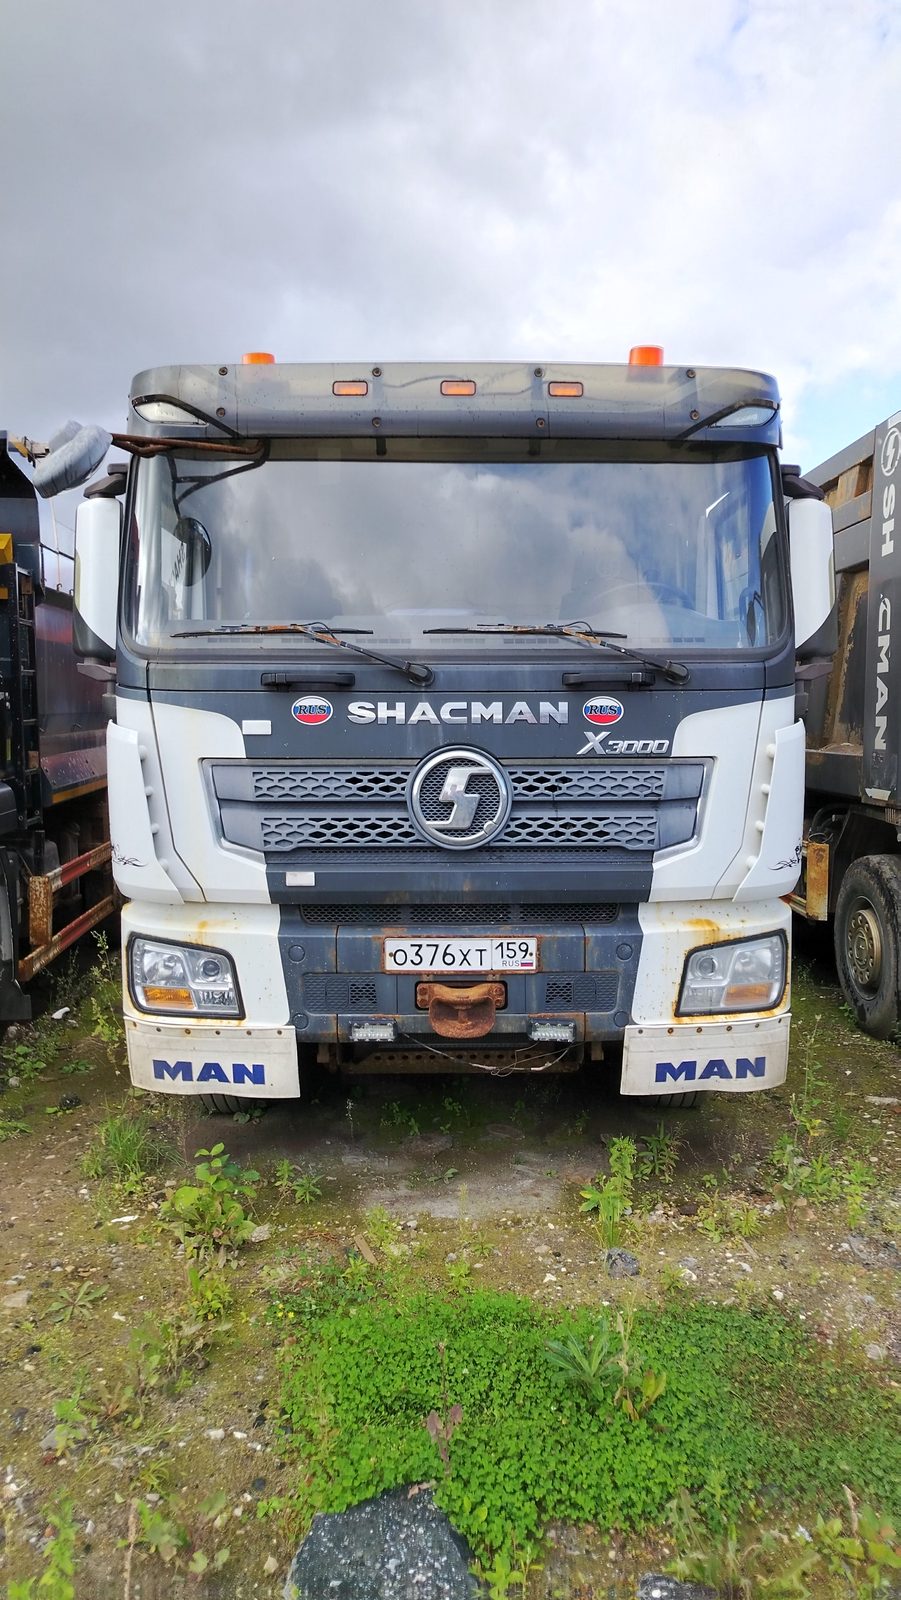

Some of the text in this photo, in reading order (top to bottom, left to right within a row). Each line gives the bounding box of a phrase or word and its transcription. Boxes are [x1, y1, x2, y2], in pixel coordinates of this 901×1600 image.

[297, 704, 327, 715] RUS
[347, 701, 568, 725] SHACMAN
[588, 704, 618, 715] RUS
[576, 731, 670, 755] X3000
[495, 942, 529, 960] 159
[152, 1059, 266, 1085] MAN
[655, 1056, 767, 1083] MAN
